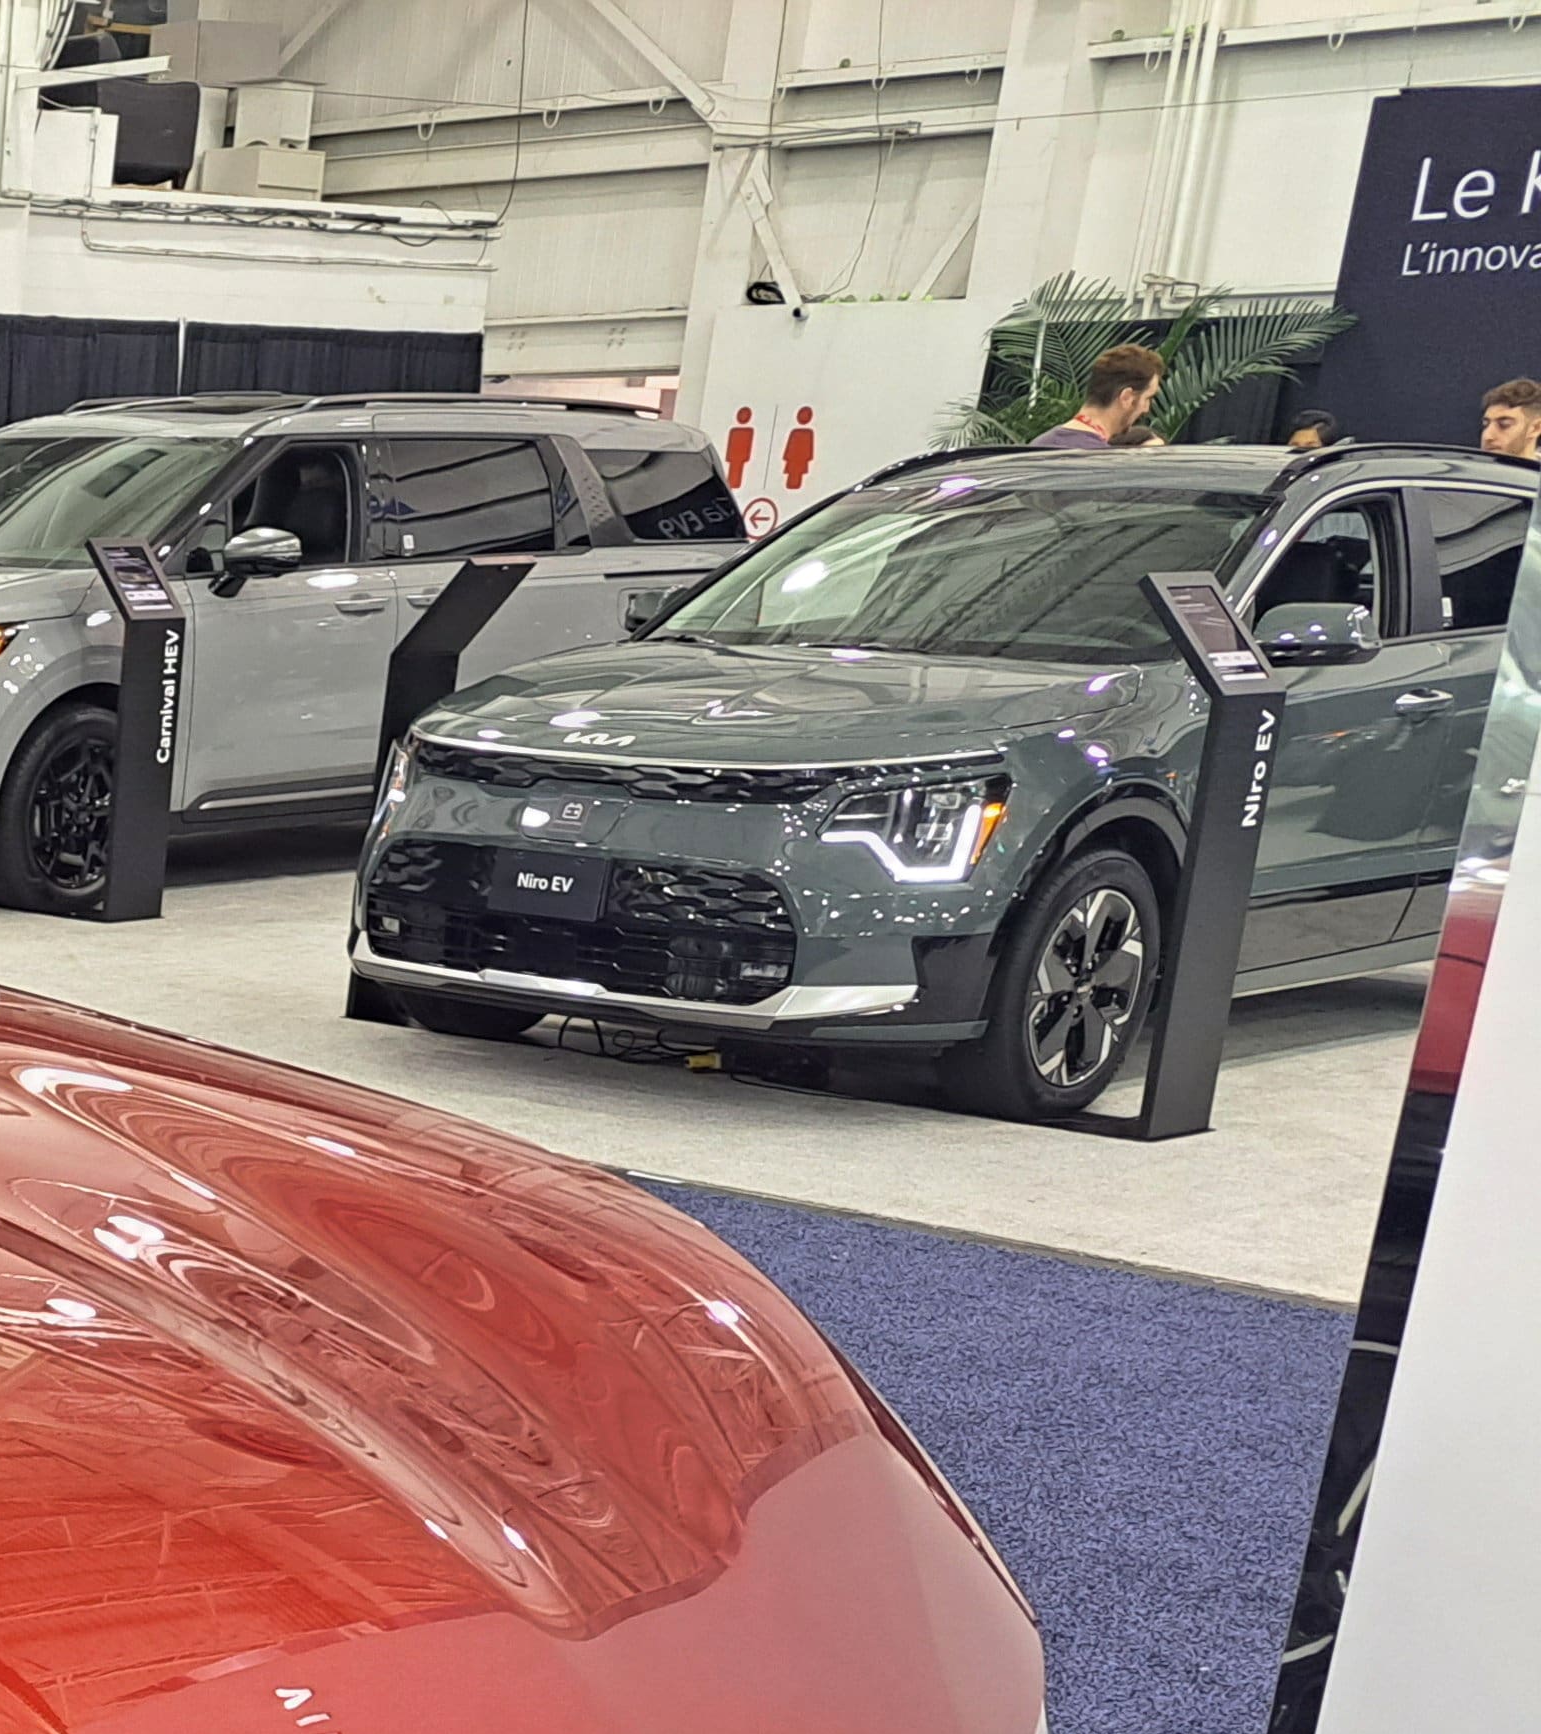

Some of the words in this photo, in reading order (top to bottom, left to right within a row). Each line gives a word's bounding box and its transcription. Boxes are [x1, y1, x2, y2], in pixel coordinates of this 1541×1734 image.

[1411, 156, 1495, 221] Le
[163, 629, 181, 675] HEV
[156, 678, 177, 765] Carnival
[1241, 760, 1267, 828] Niro
[1255, 709, 1276, 751] EV
[517, 872, 549, 890] Niro
[550, 876, 574, 893] EV
